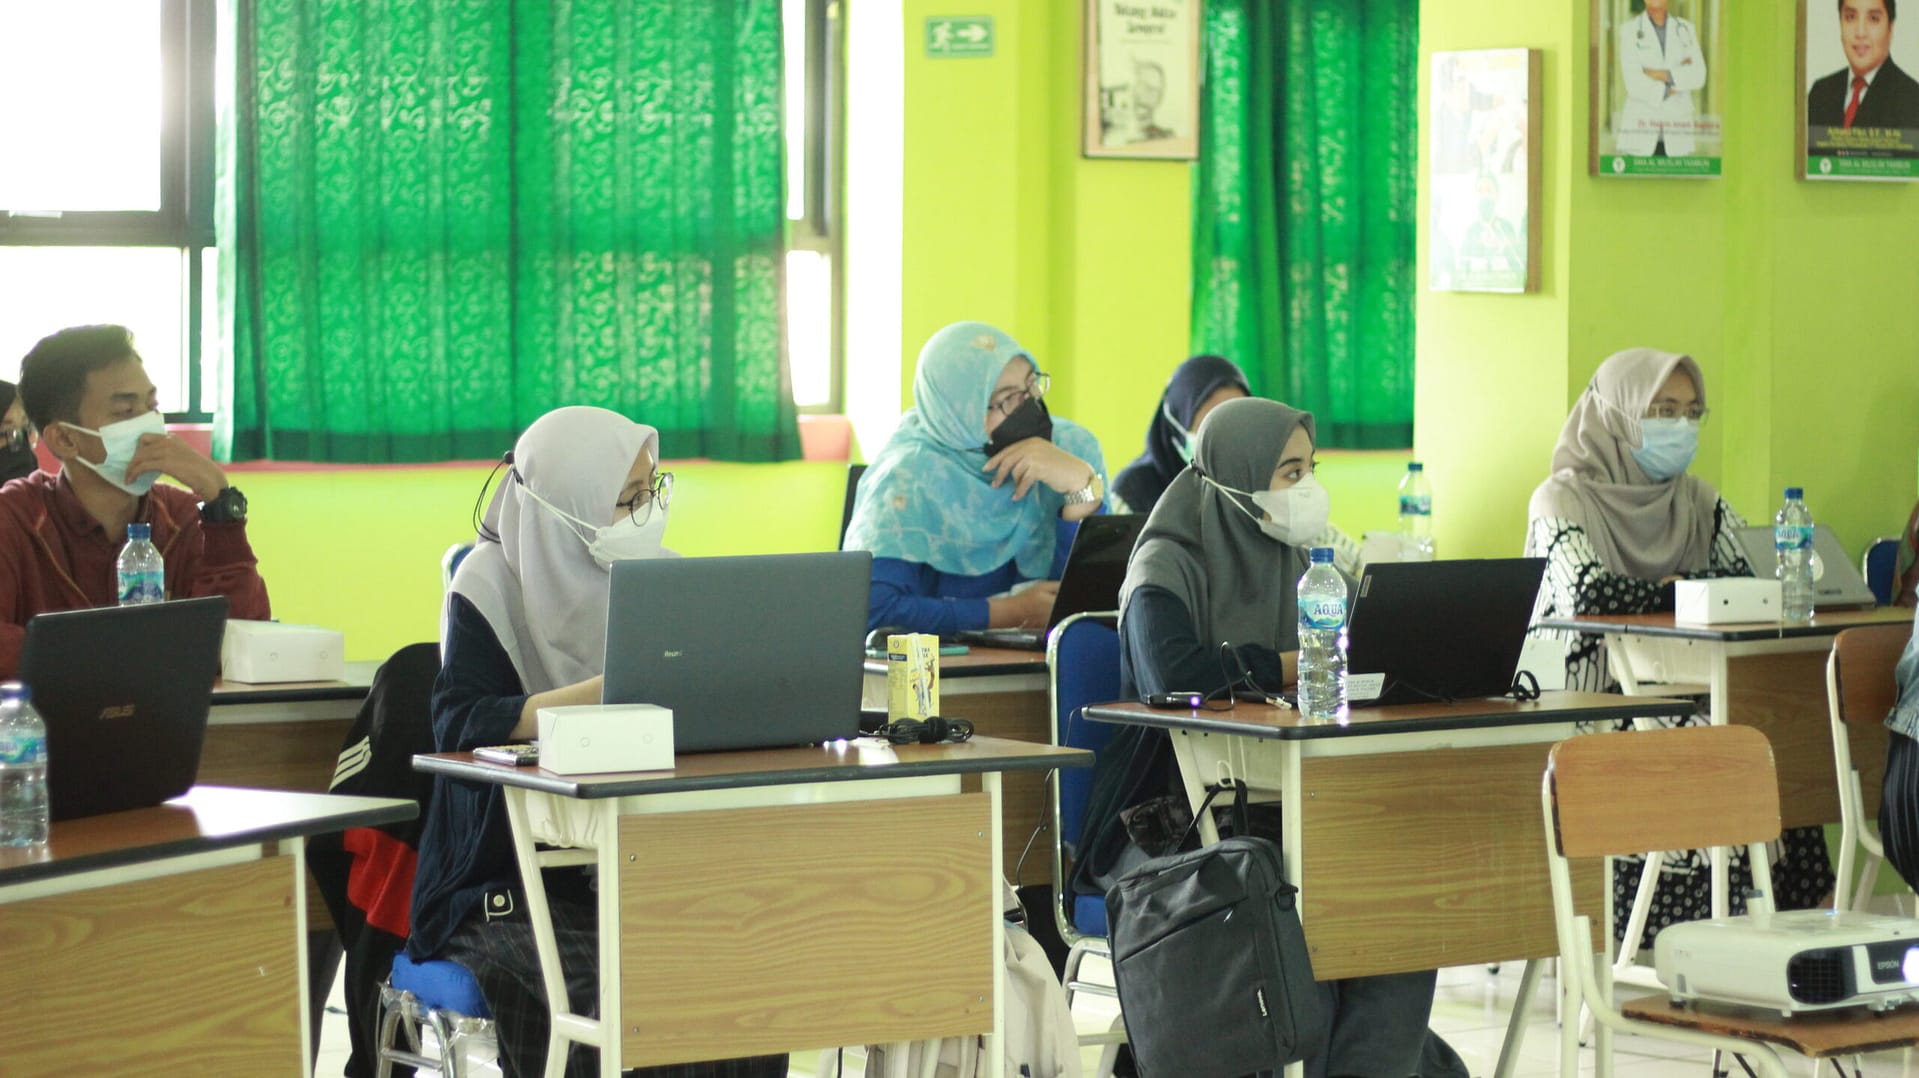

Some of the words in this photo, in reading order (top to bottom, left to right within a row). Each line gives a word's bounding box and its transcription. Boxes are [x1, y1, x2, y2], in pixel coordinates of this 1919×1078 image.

[1314, 603, 1343, 617] AQUA
[99, 704, 135, 720] ASUS
[1877, 960, 1900, 970] EPSON
